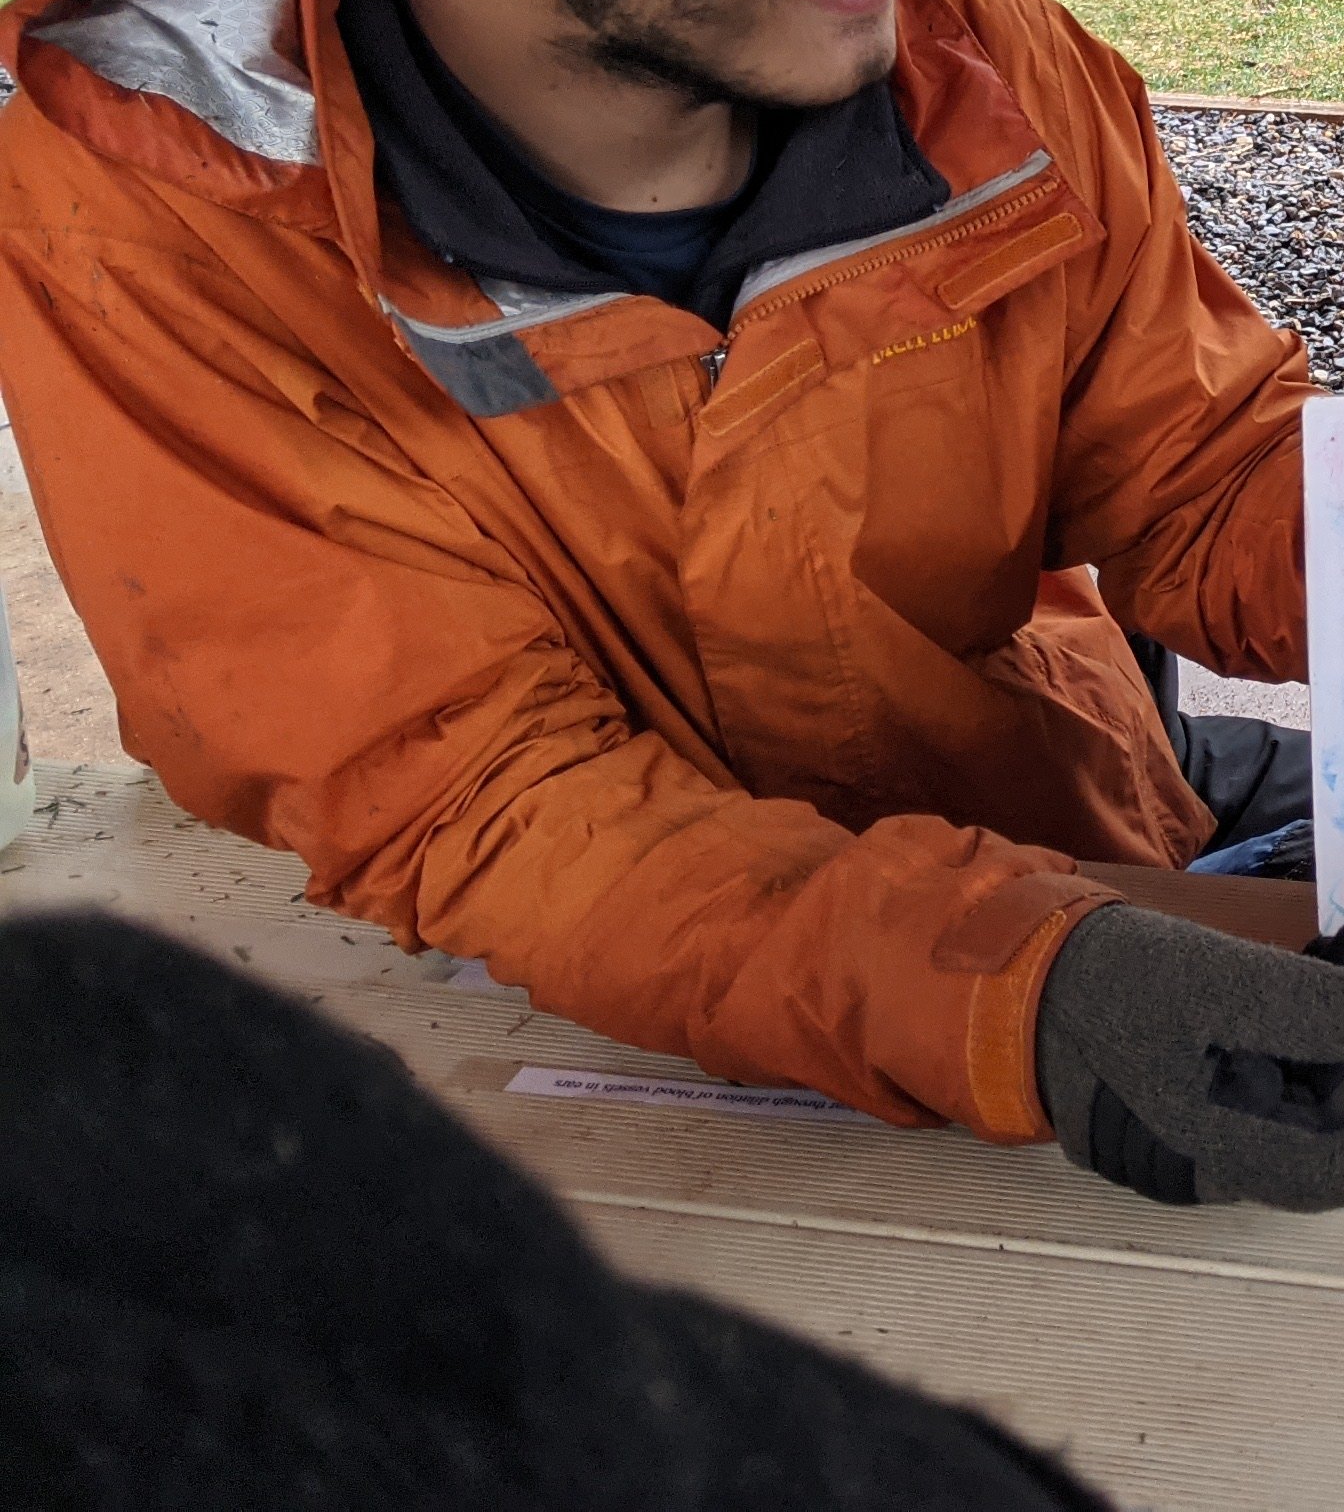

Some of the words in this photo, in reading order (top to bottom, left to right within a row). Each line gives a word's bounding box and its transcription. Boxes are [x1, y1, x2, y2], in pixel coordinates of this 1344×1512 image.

[554, 1079, 583, 1087] ears
[585, 1082, 599, 1091] in
[601, 1083, 650, 1093] vessels
[651, 1087, 693, 1099] blood
[692, 1091, 713, 1100] of
